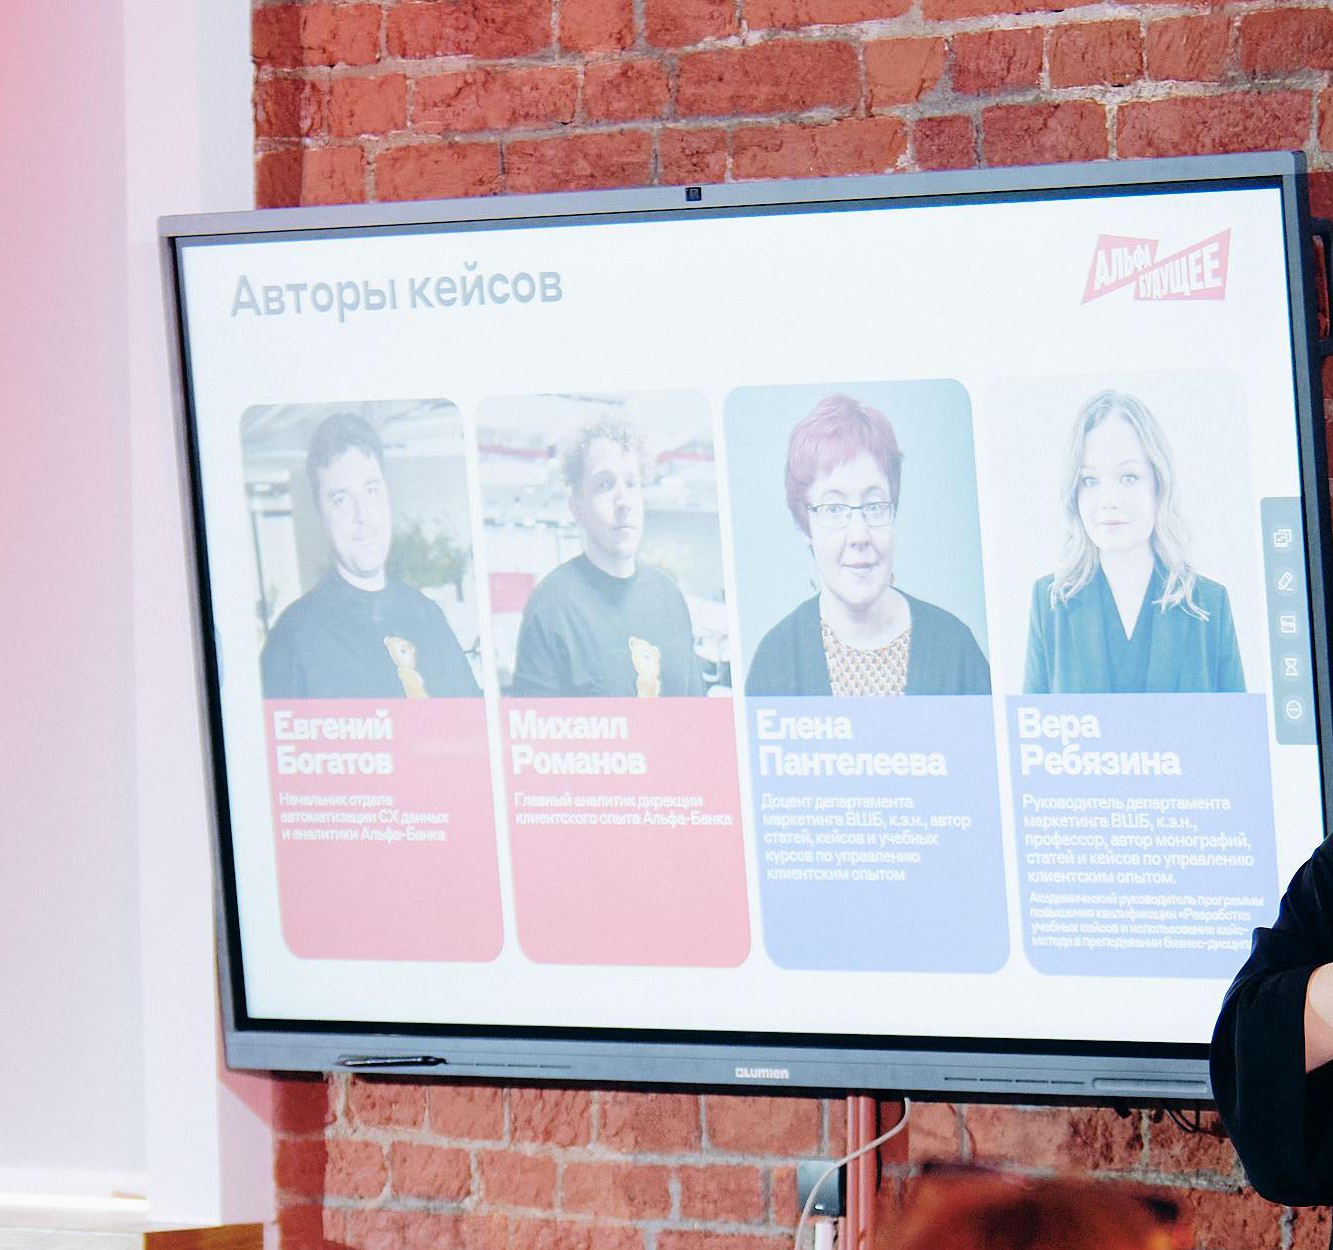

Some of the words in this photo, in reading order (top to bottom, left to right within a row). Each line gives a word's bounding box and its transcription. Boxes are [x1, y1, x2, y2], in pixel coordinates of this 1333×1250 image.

[1093, 244, 1153, 291] АЛЬФА
[230, 274, 397, 323] Авторы
[409, 260, 563, 309] кейсов
[273, 708, 393, 740] Евгений
[509, 709, 628, 740] Михаил
[756, 709, 853, 740] Елена
[1017, 707, 1101, 746] Вера
[276, 745, 394, 775] Богатов
[511, 744, 647, 775] Романов
[758, 745, 947, 776] Пантелеева
[1020, 743, 1182, 776] Ребязина
[279, 791, 347, 806] Начальник
[349, 794, 393, 808] отдела
[514, 792, 572, 807] Главный
[761, 793, 812, 810] Доцент
[815, 795, 914, 811] департамента
[1022, 794, 1124, 812] Руководитель
[1125, 797, 1231, 813] департамента
[400, 811, 450, 827] данных
[599, 812, 641, 826] опыта
[642, 810, 733, 828] Альфа-Банка
[762, 815, 843, 829] маркетинга
[845, 812, 887, 829] ВШБ,
[930, 814, 971, 830] автор
[1023, 817, 1109, 831] маркетинга
[1110, 813, 1154, 831] ВШБ,
[361, 826, 446, 844] Альфа-Банка
[816, 829, 865, 844] кейсов
[878, 830, 938, 847] учебных
[1025, 831, 1109, 850] профессор,
[1110, 834, 1154, 850] автор
[1155, 832, 1251, 850] монографий,
[765, 850, 813, 865] курсов
[816, 851, 834, 863] по
[835, 850, 921, 865] управлению
[1026, 850, 1074, 865] статей
[1076, 854, 1087, 865] и
[1089, 850, 1140, 866] кейсов
[1142, 854, 1162, 867] по
[1163, 853, 1255, 870] управлению
[851, 868, 906, 881] опытом
[1028, 871, 1115, 884] клиентским
